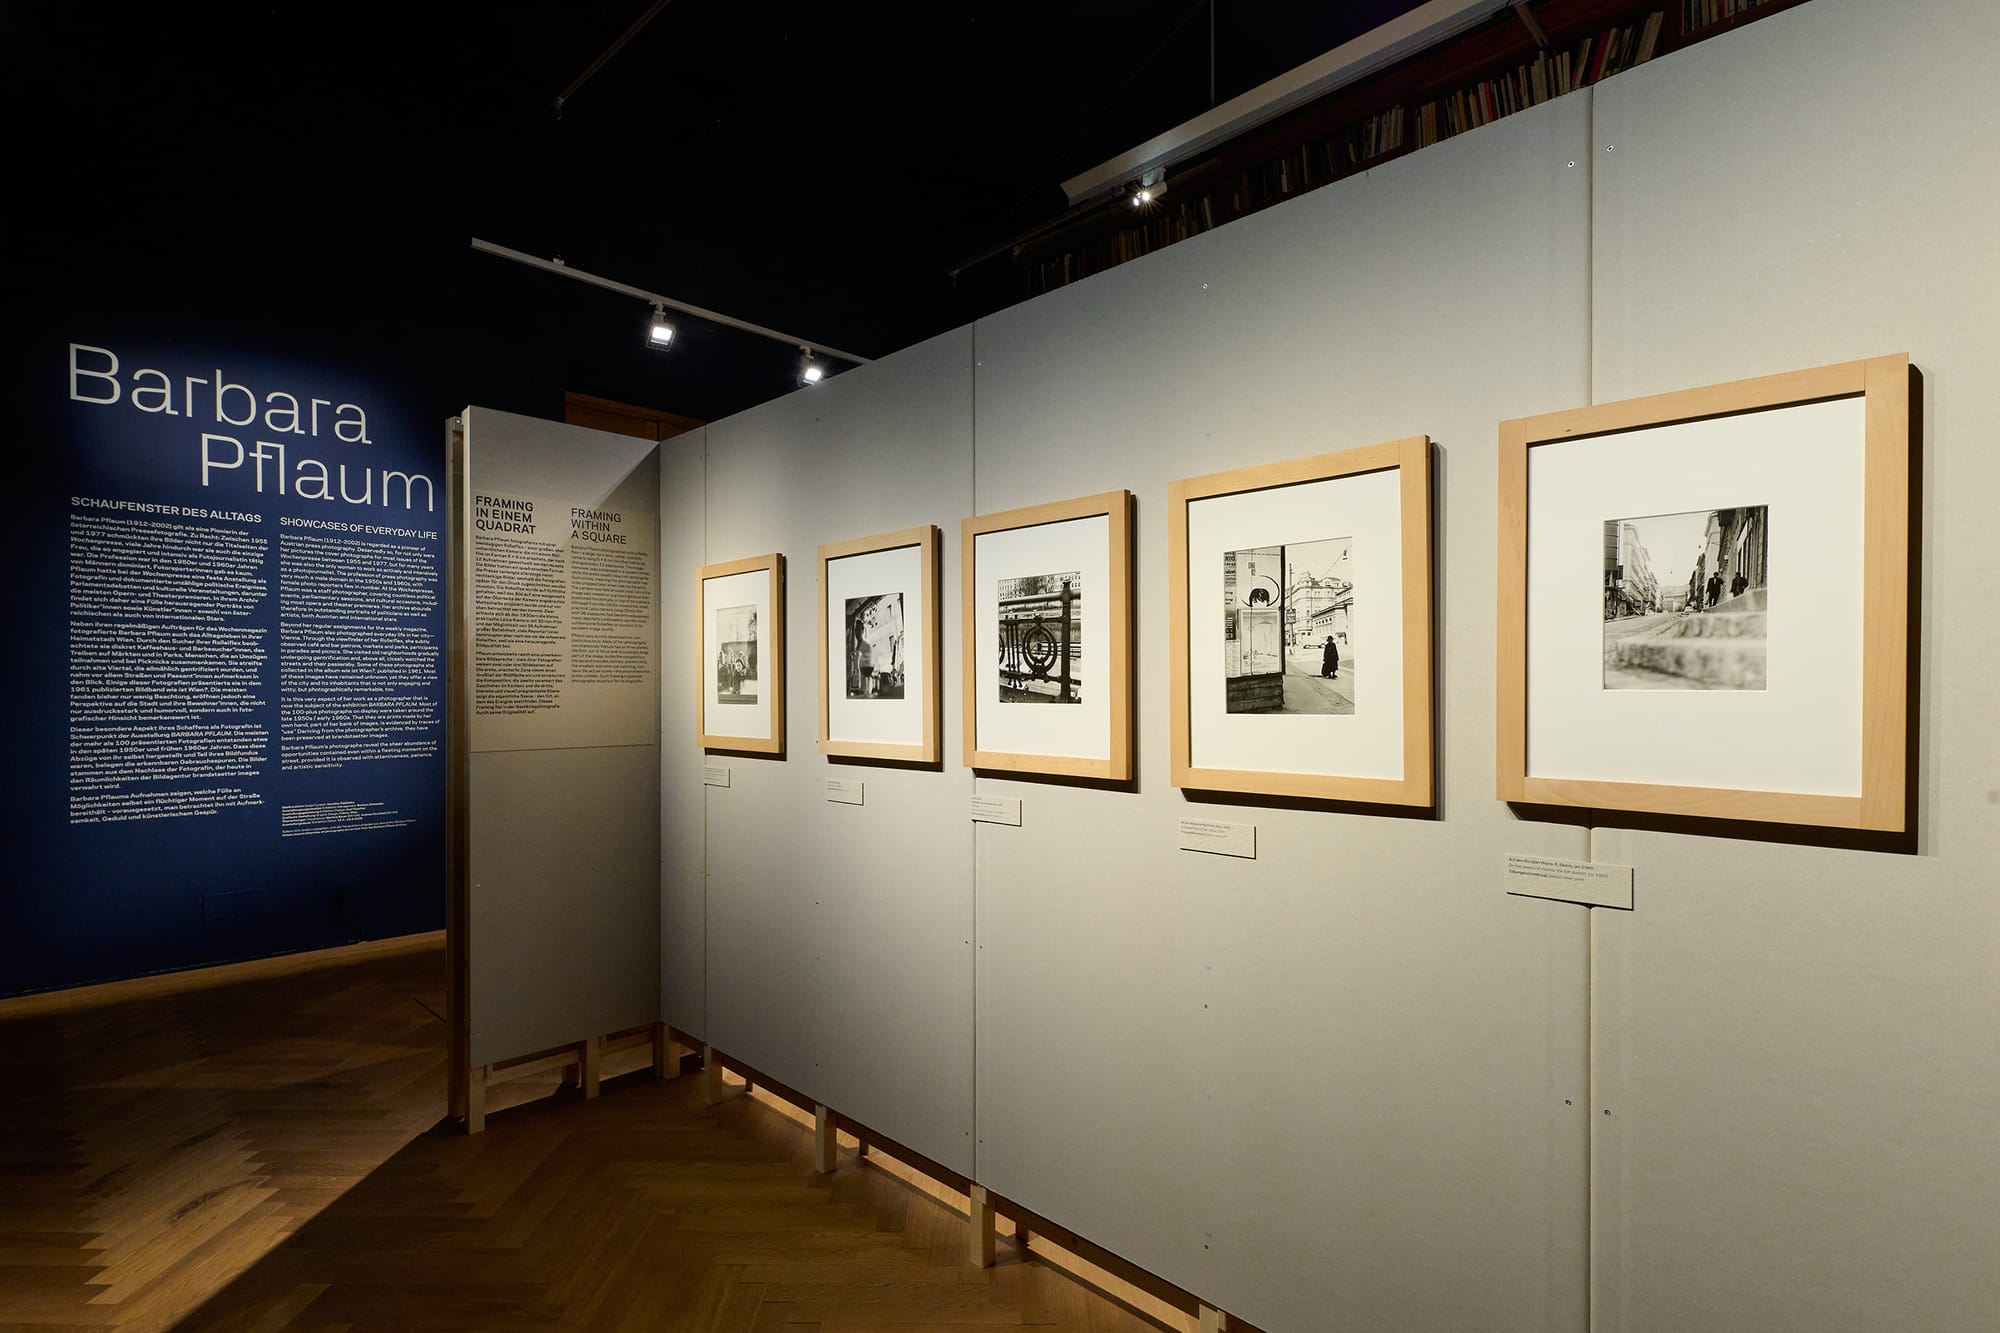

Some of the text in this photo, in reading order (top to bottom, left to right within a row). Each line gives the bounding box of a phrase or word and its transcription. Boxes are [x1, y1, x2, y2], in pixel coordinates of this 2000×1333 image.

[69, 342, 372, 445] Barbara
[201, 432, 434, 512] Pflaum
[71, 496, 262, 523] SCHAUFENSTER DES ALLTAGS
[475, 495, 534, 512] FRAMING
[71, 514, 99, 522] Barbara
[101, 517, 125, 525] Pflaum
[475, 507, 532, 523] IN EINEM
[571, 507, 622, 523] FRAMING
[280, 517, 438, 540] SHOWCASES OF EVERYDAY LIFE
[475, 519, 537, 534] QUADRAT
[571, 519, 610, 532] WITHIN
[571, 530, 627, 545] A SQUARE
[212, 561, 236, 569] 1960er
